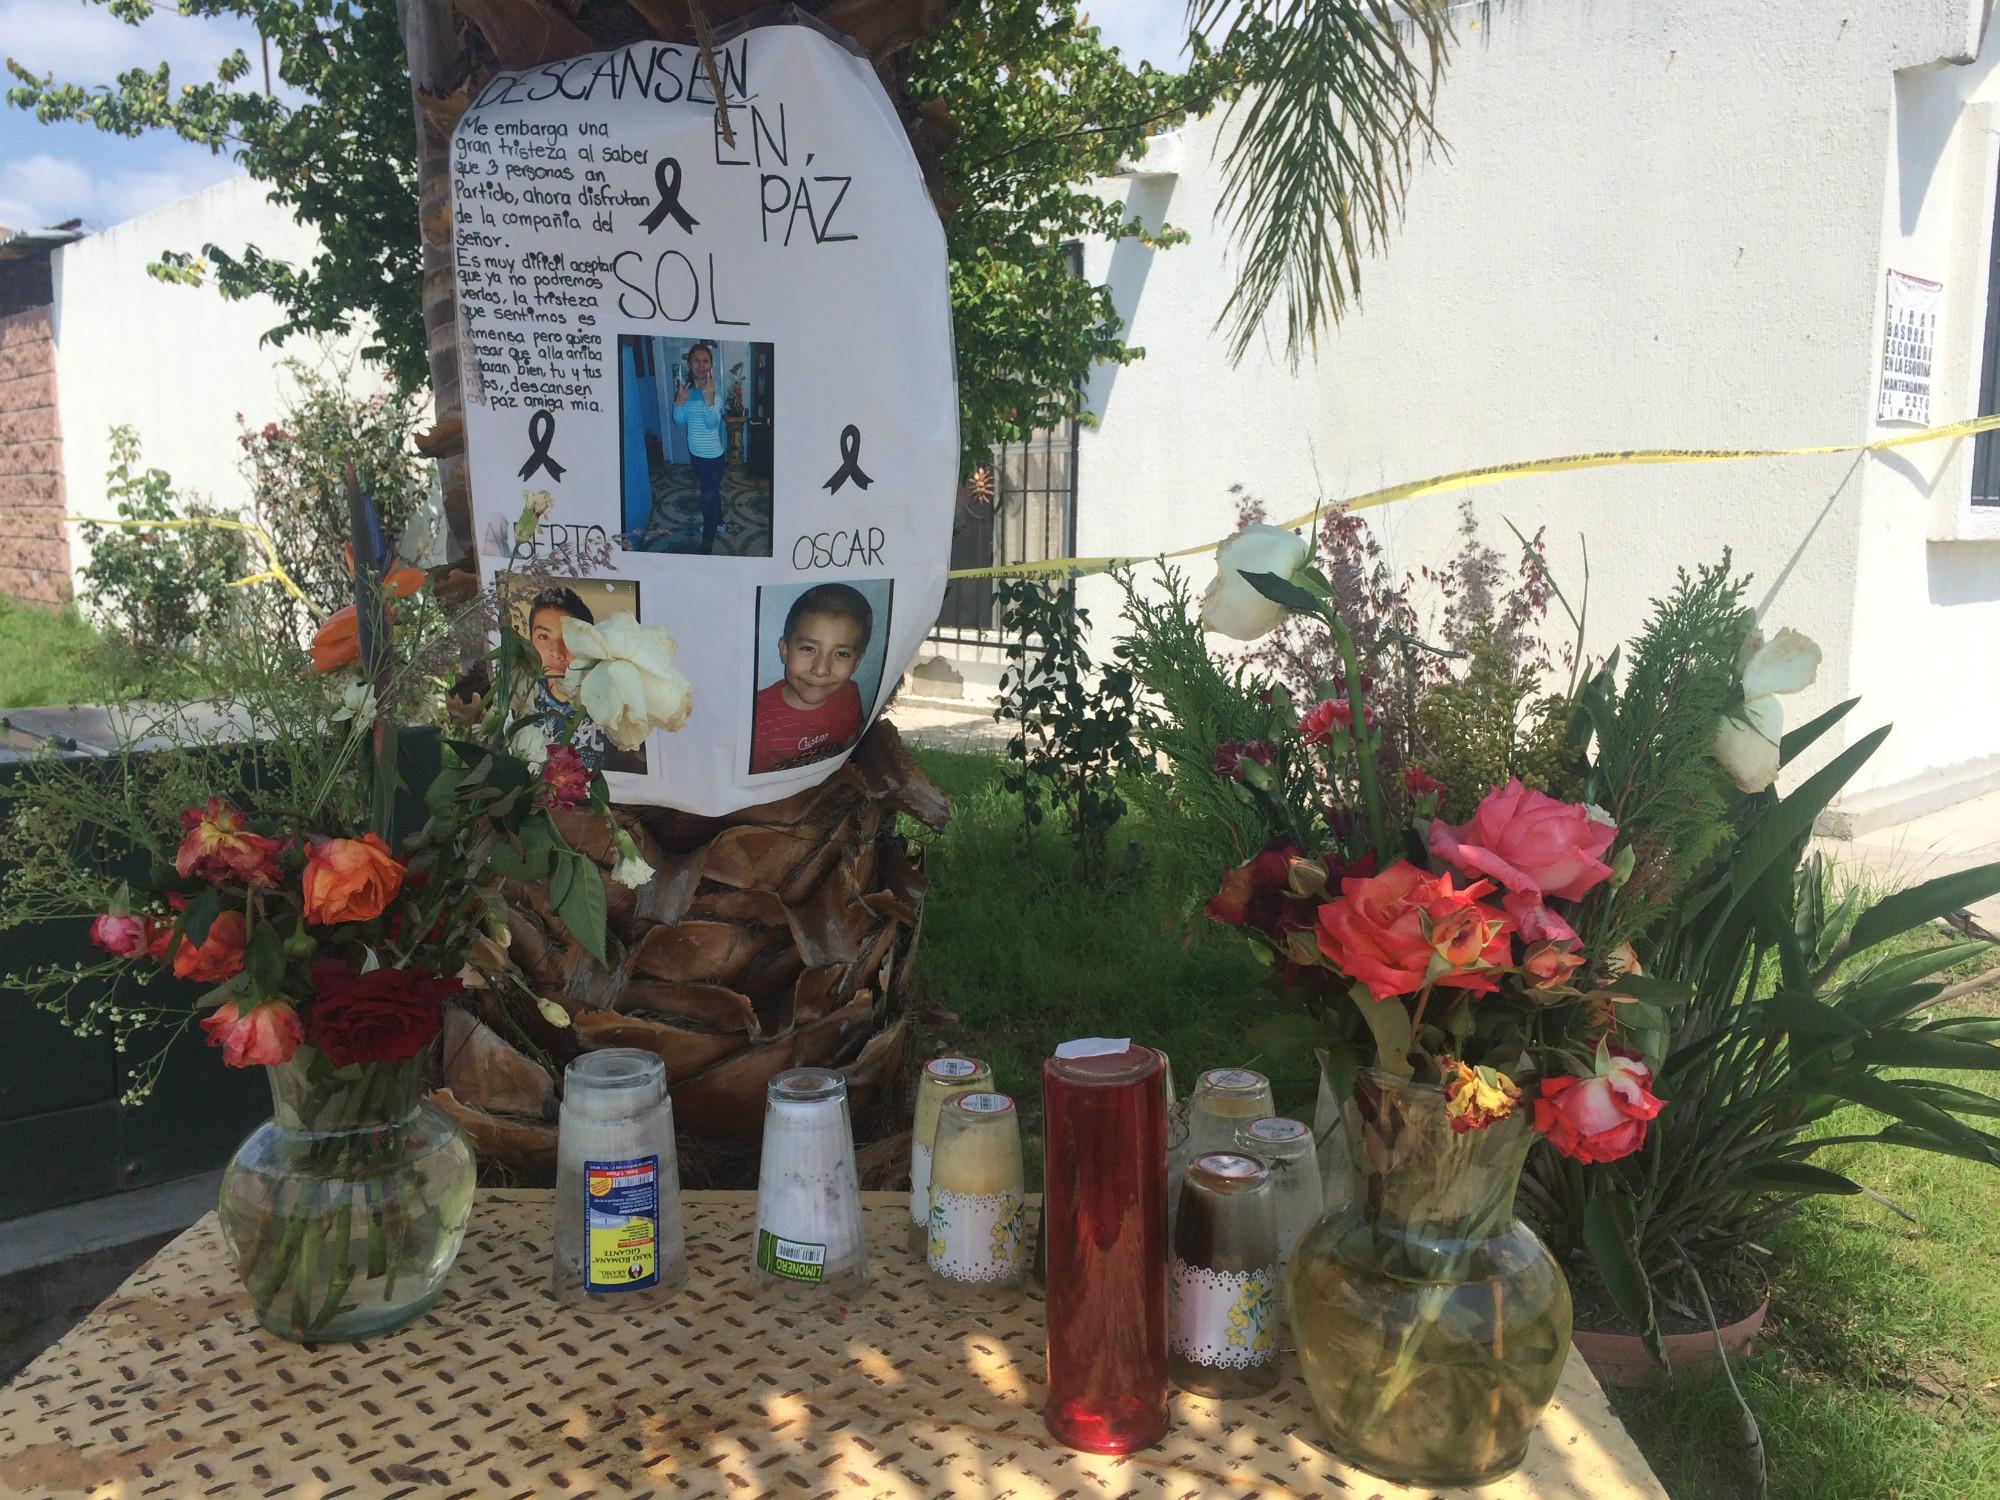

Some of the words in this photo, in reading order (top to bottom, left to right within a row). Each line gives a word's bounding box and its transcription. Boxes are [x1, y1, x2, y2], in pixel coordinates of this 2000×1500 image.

[472, 38, 748, 110] DESCANSEN
[462, 116, 488, 136] Me
[495, 119, 568, 146] embarga
[578, 122, 609, 138] una
[714, 102, 788, 168] EN
[456, 137, 491, 159] gran
[499, 138, 566, 161] tristeza
[578, 144, 594, 162] al
[602, 144, 649, 164] saber
[455, 160, 480, 178] que
[486, 159, 499, 175] 3
[505, 163, 575, 182] personas
[585, 169, 606, 183] an
[523, 187, 571, 206] ahora
[578, 184, 650, 207] disfrutan
[455, 203, 473, 224] de
[481, 205, 496, 227] la
[592, 210, 613, 233] del
[457, 247, 481, 268] Es
[485, 257, 515, 277] muy
[570, 256, 615, 278] aceptar
[457, 269, 482, 286] que
[485, 271, 502, 287] ya
[508, 274, 527, 286] no
[534, 274, 603, 290] podremos
[613, 249, 751, 326] SOL
[513, 290, 528, 305] la
[534, 291, 599, 308] tristeza
[494, 306, 567, 324] sentimos
[578, 314, 596, 325] es
[533, 331, 563, 347] pero
[565, 328, 602, 346] quiero
[1887, 321, 1926, 343] BASURA
[508, 347, 531, 363] que
[538, 347, 565, 361] alla
[566, 345, 602, 361] arriba
[1884, 355, 1894, 371] EN
[1894, 358, 1903, 374] LA
[517, 360, 546, 379] bien,
[550, 363, 566, 379] tu
[571, 368, 580, 382] y
[585, 365, 602, 379] tus
[510, 377, 592, 396] descansen
[523, 395, 564, 413] amiga
[1881, 391, 1893, 406] EL
[792, 527, 886, 571] OSCAR
[603, 1247, 641, 1256] GIGANTE
[776, 1258, 822, 1276] LIMONERO
